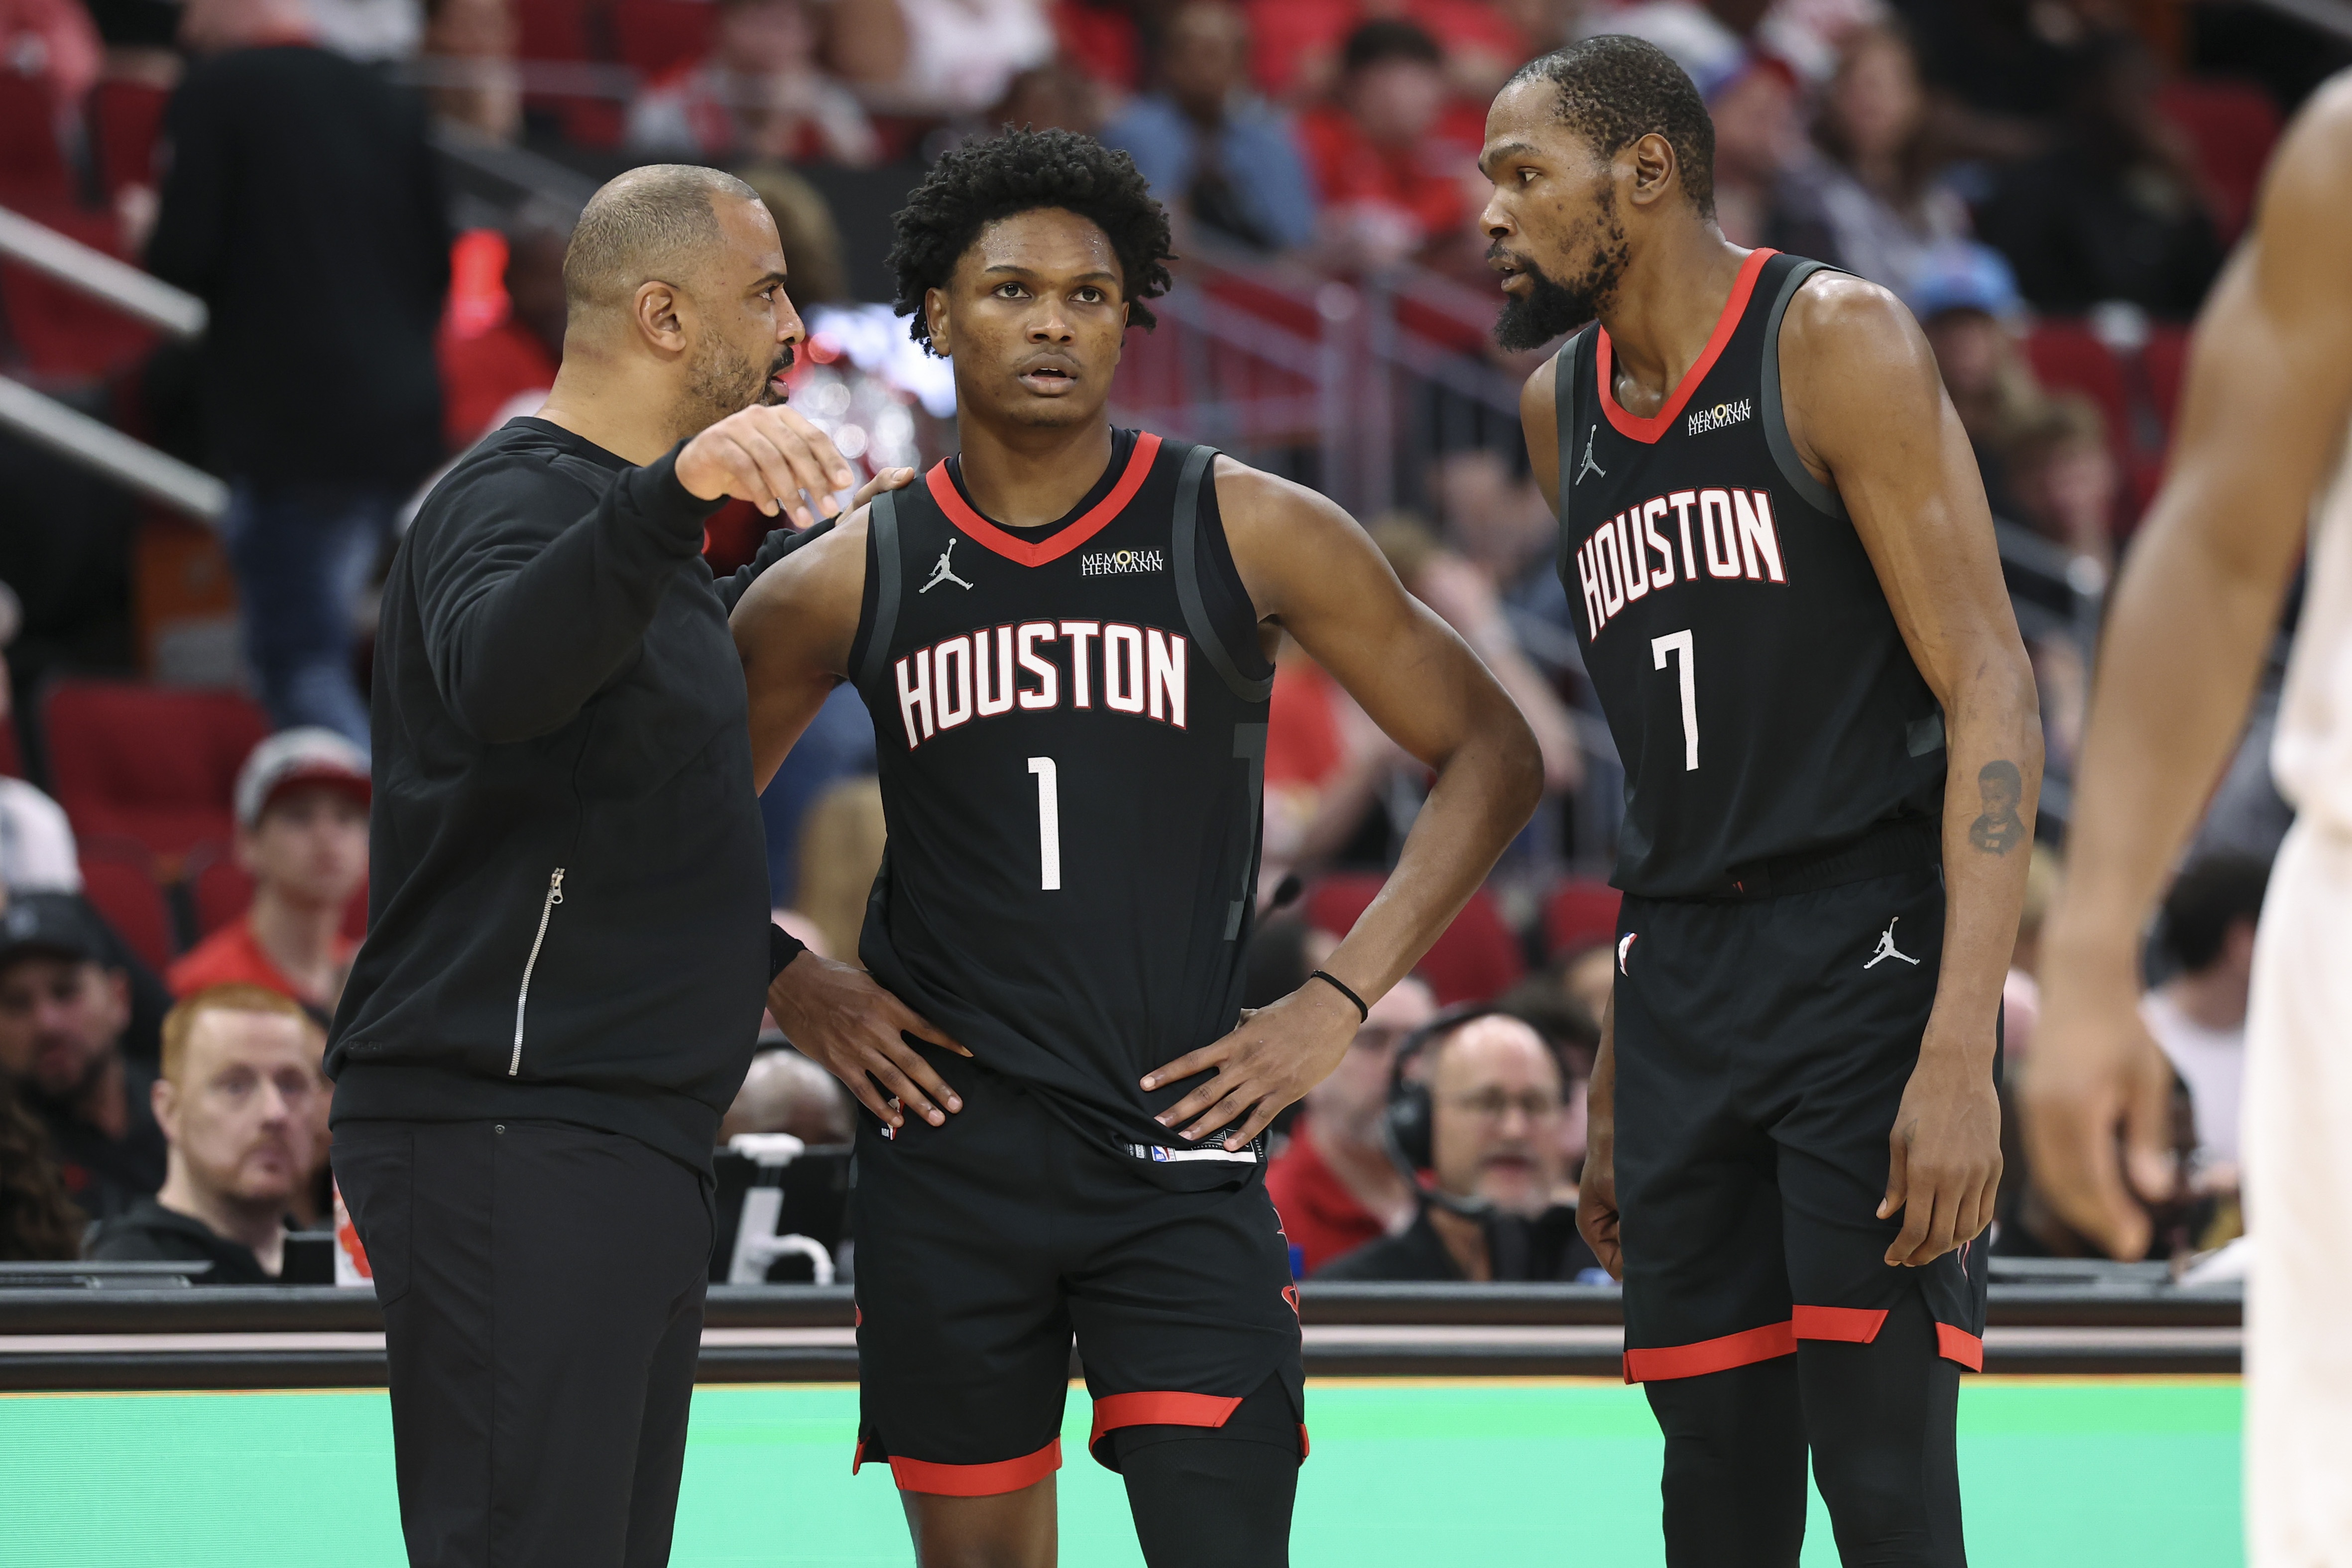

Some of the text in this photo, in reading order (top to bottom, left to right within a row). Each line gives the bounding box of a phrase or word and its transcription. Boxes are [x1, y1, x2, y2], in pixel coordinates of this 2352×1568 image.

[1688, 398, 1751, 426] MEMORIAL
[1688, 408, 1750, 436] HERMANN
[1082, 550, 1163, 565] MEMORIAL
[1082, 560, 1162, 576] HERMANN
[1576, 487, 1787, 643] HOUSTON
[894, 619, 1189, 752] HOUSTON
[1651, 629, 1699, 771] 7
[1028, 756, 1060, 890] 1
